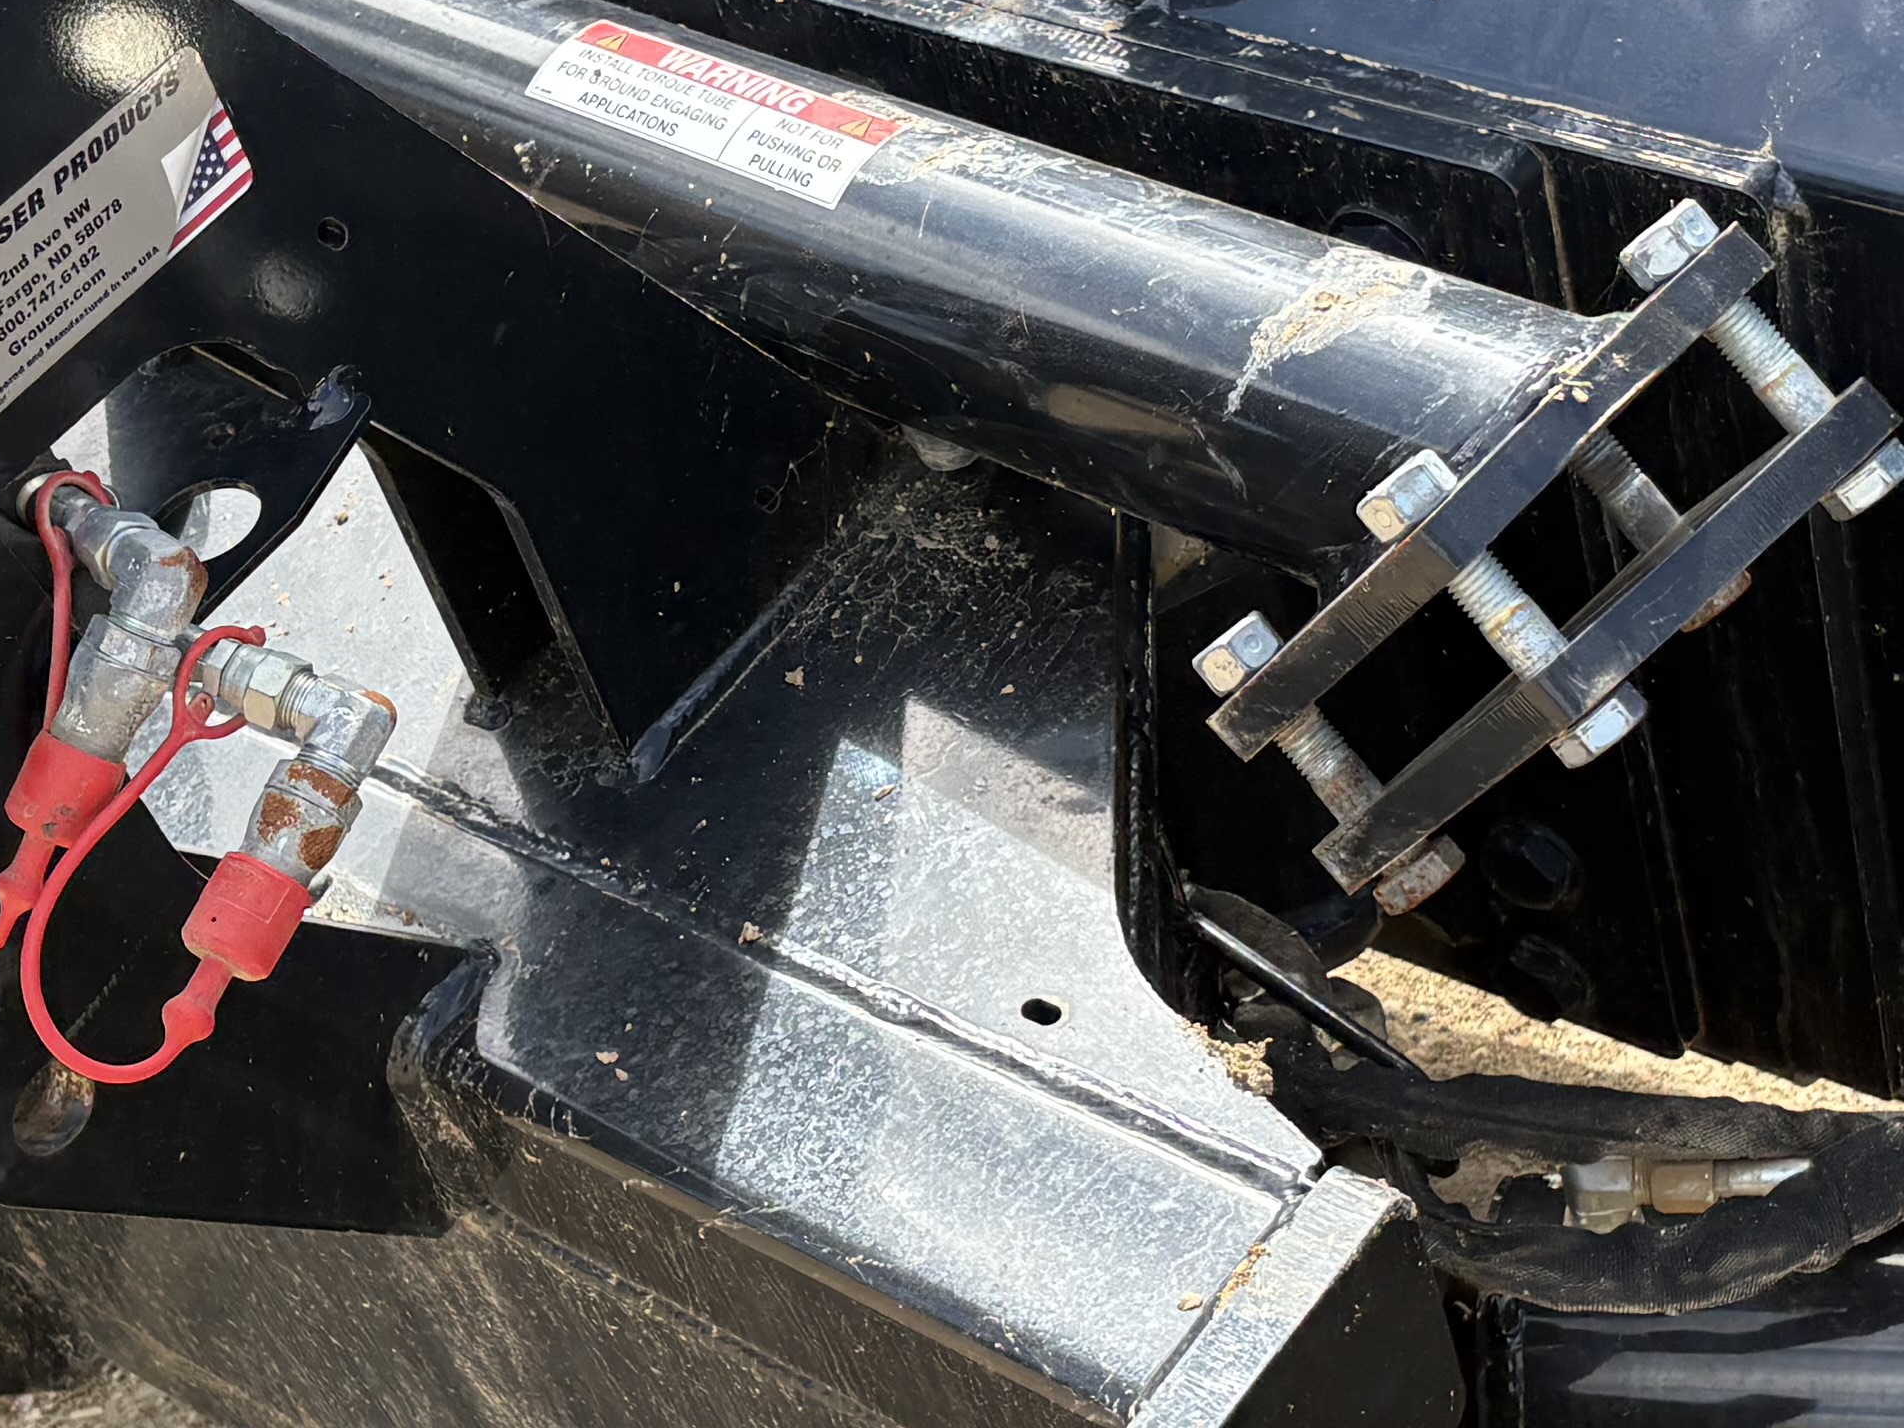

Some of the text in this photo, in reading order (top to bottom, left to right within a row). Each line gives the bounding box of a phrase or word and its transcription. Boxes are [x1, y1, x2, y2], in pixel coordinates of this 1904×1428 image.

[556, 61, 728, 131] FOR GROUND ENGAGING
[579, 48, 737, 111] INSTALL TORQUE TUBE
[657, 48, 816, 114] WARNING
[53, 70, 180, 195] PRODUCTS
[577, 92, 679, 137] APPLICATIONS
[775, 118, 844, 149] NOT FOR
[747, 129, 842, 173] PUSHING OR
[748, 154, 813, 188] PULLING
[48, 243, 72, 270] ND
[75, 198, 123, 246] 58078
[63, 197, 92, 229] NW
[138, 246, 160, 267] USA
